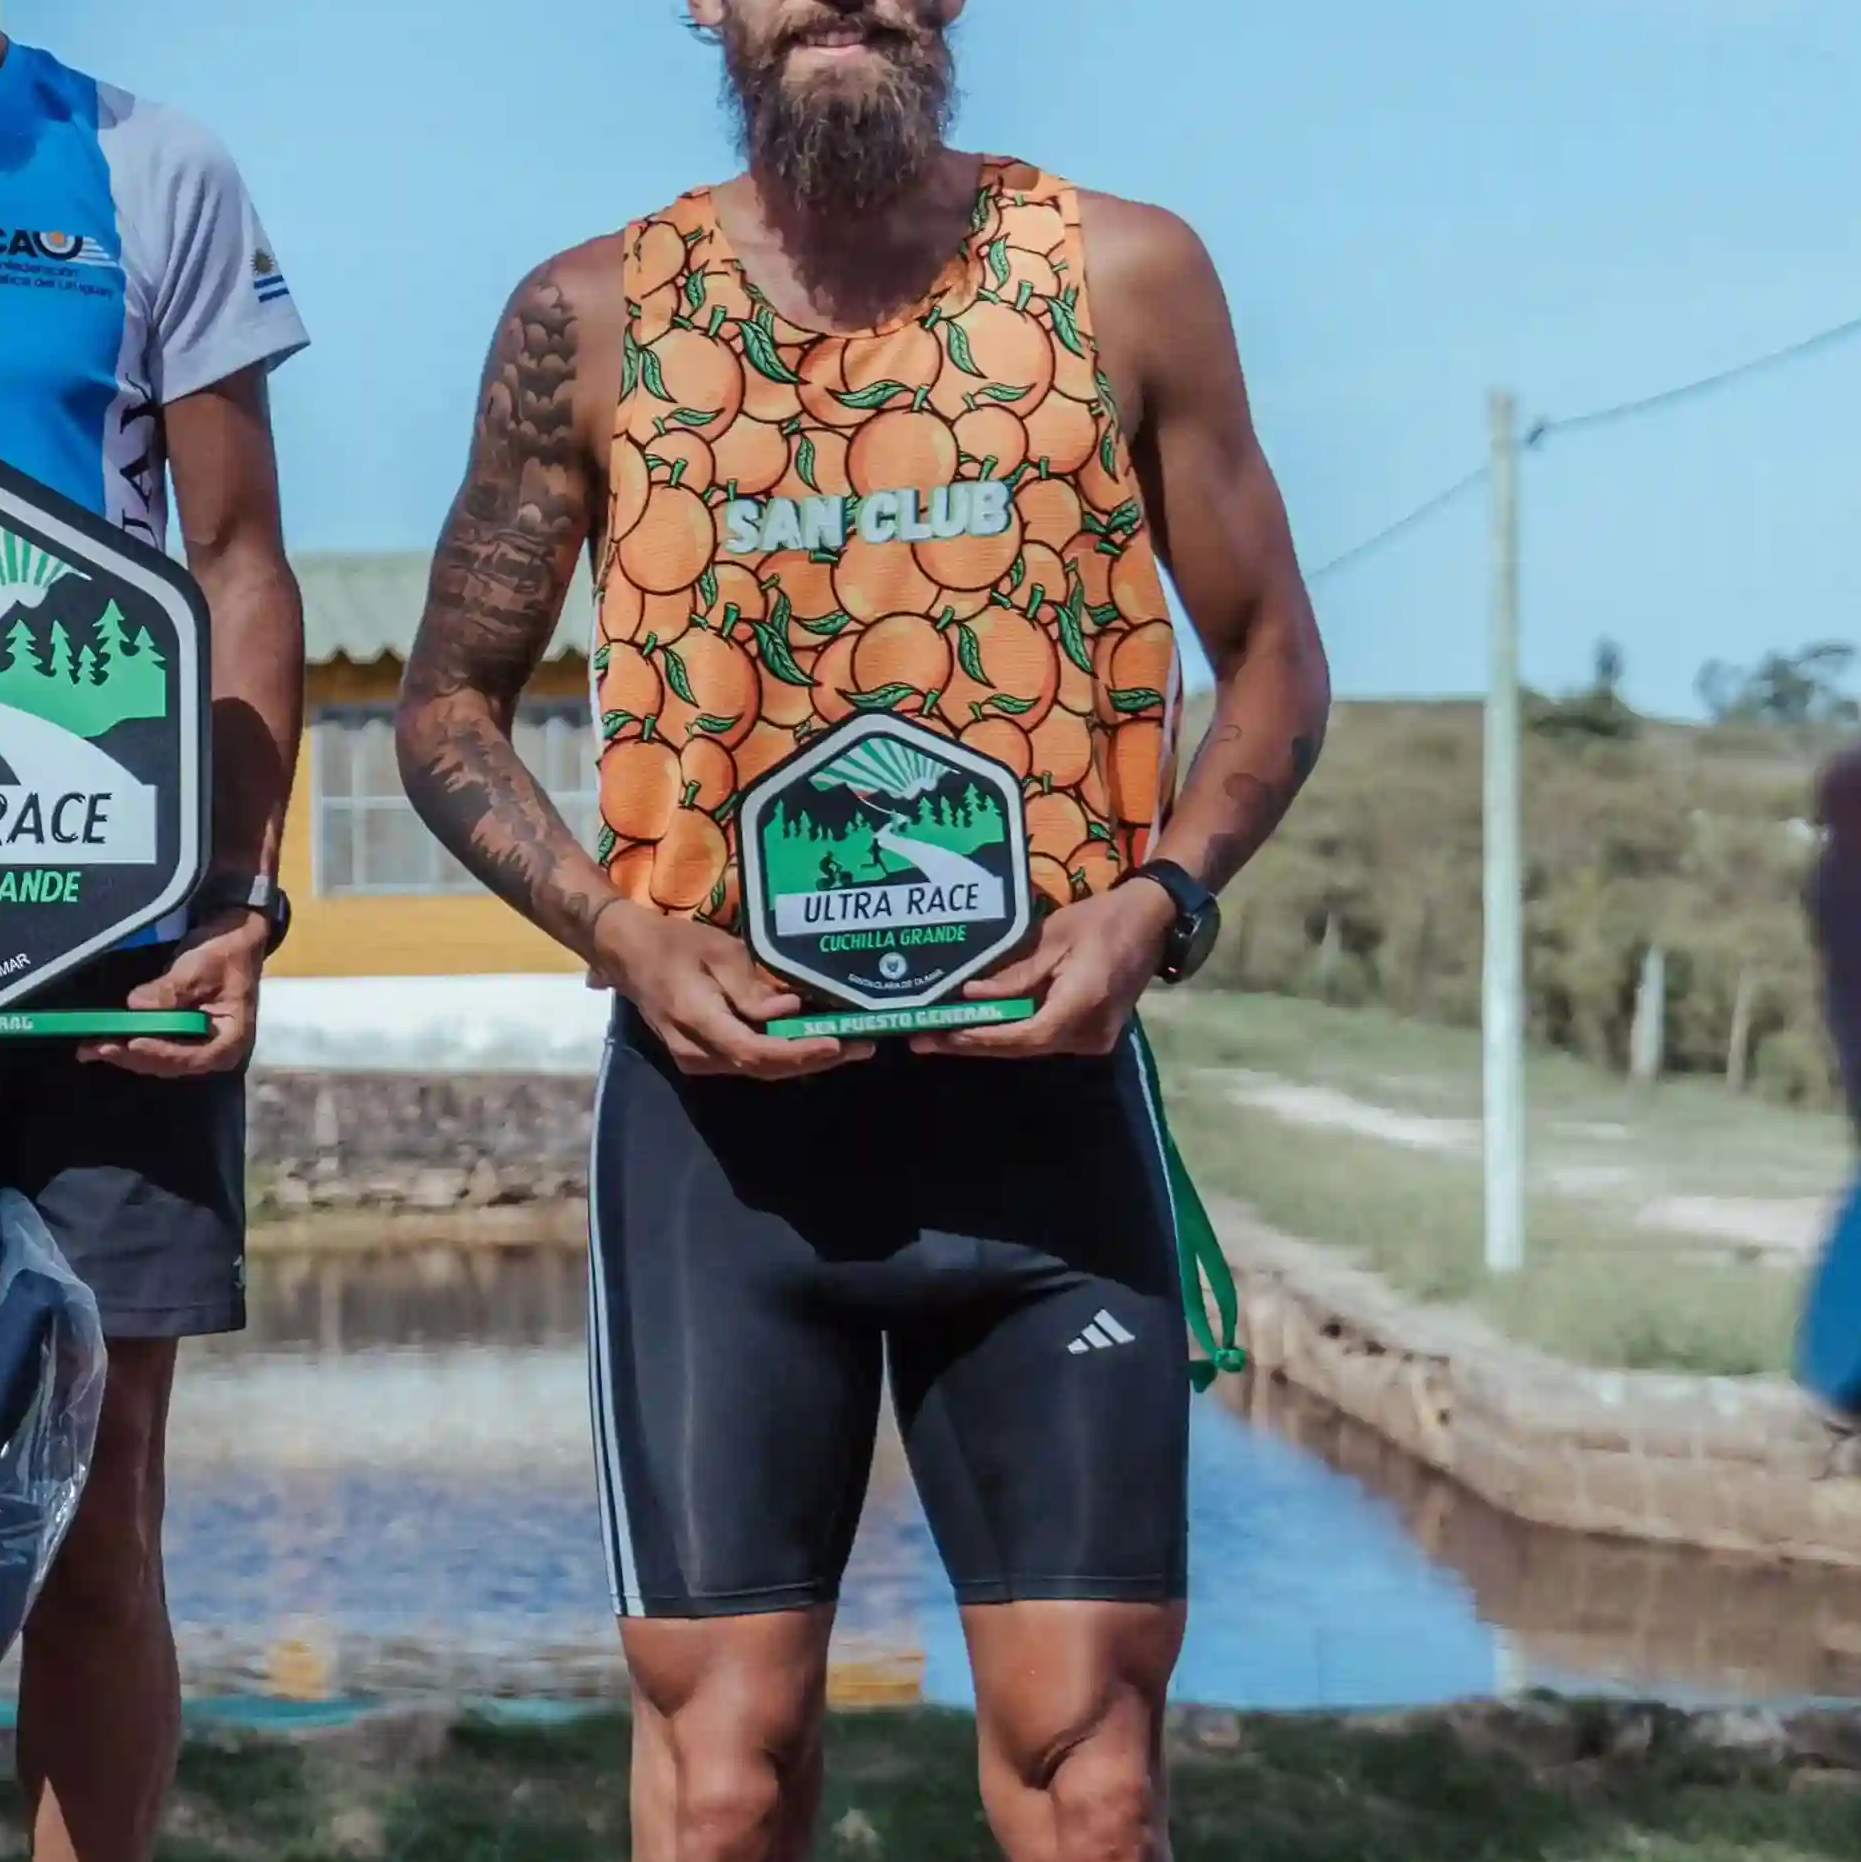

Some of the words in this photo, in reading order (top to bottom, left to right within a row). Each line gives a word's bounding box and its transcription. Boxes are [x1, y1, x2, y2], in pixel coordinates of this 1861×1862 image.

[724, 494, 845, 554] SAN
[859, 480, 1012, 544] CLUB
[804, 888, 892, 924] ULTRA
[906, 882, 979, 916] RACE
[819, 930, 896, 953] CUCHILLA
[900, 925, 967, 946] GRANDE
[841, 1013, 913, 1032] PUESTO
